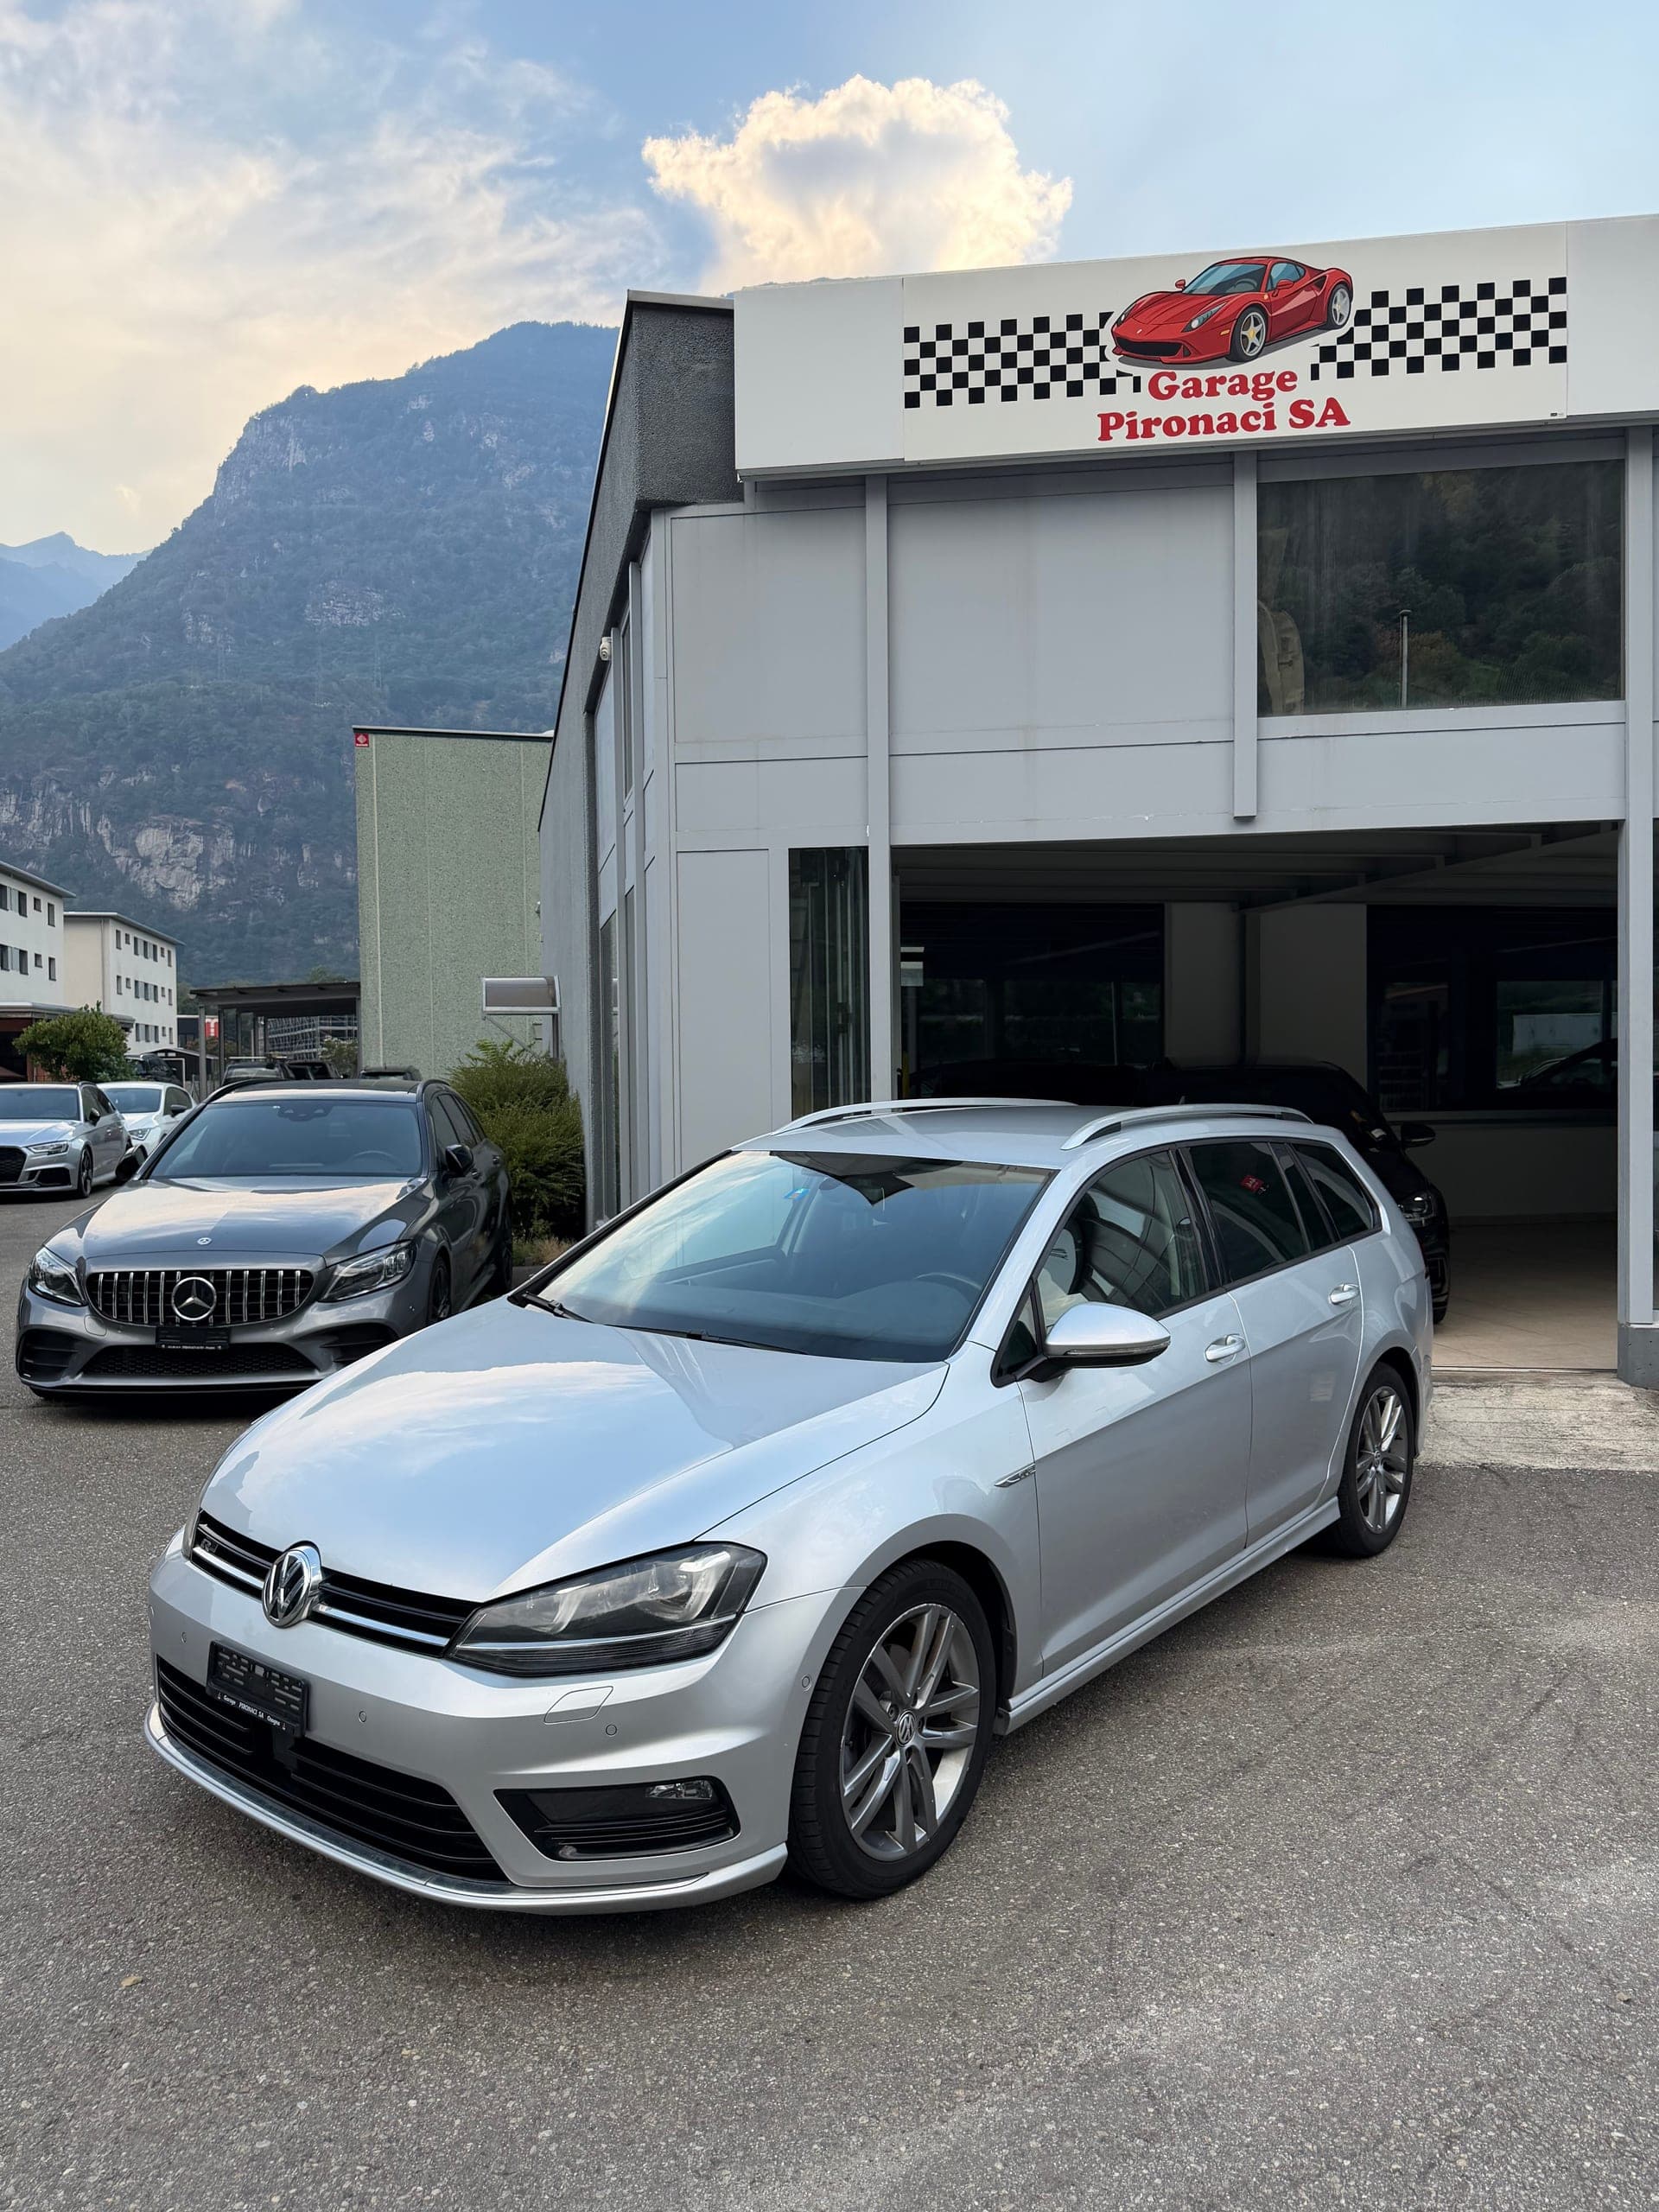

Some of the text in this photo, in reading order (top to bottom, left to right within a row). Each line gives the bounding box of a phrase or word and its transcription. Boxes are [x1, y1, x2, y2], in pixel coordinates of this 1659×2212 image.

[1147, 371, 1297, 402] Garage
[1098, 397, 1350, 442] Pironaci SA
